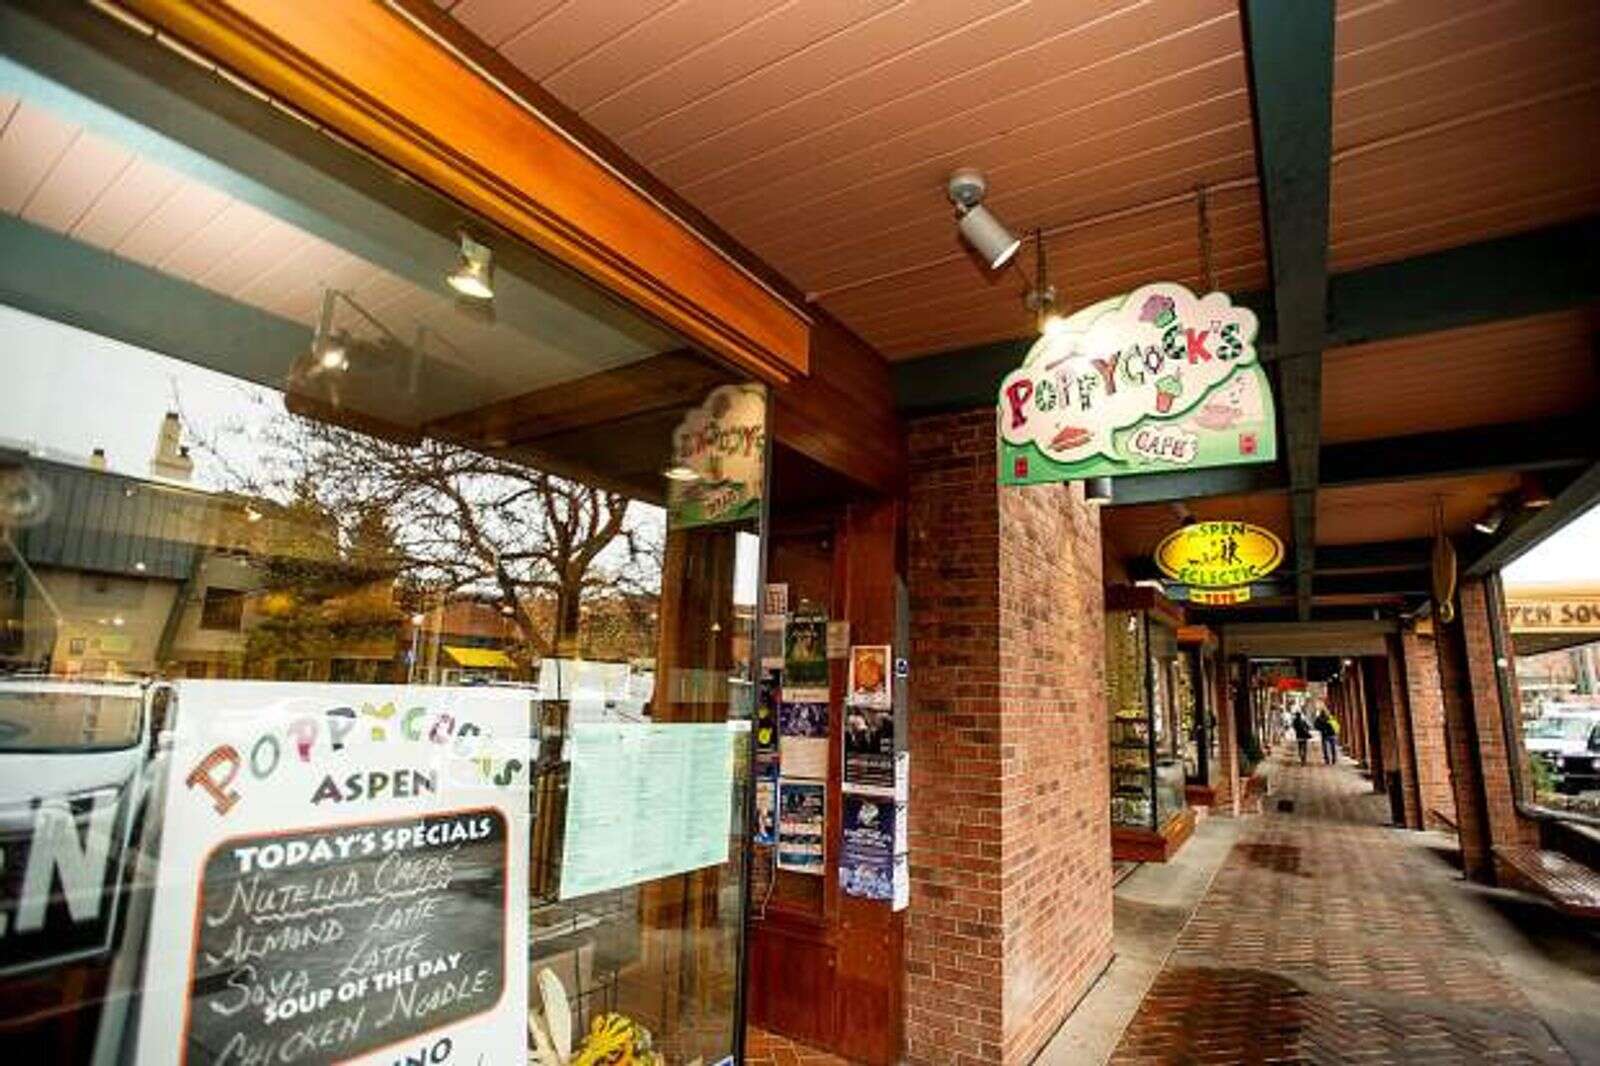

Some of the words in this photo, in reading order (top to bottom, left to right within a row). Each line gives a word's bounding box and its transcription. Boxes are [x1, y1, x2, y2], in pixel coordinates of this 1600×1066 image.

[310, 768, 438, 805] ASPEN
[234, 831, 376, 872] TODAY'S
[381, 817, 492, 852] SPECIALS
[206, 868, 360, 927] NUTELLA
[206, 918, 344, 965] ALMOND
[364, 897, 442, 933] LATTE
[338, 931, 430, 978] LATTE
[264, 988, 334, 1025] SOUP
[338, 977, 370, 1002] OF
[372, 964, 414, 992] THE
[418, 952, 462, 980] DAY
[375, 969, 491, 1028] NOODLE
